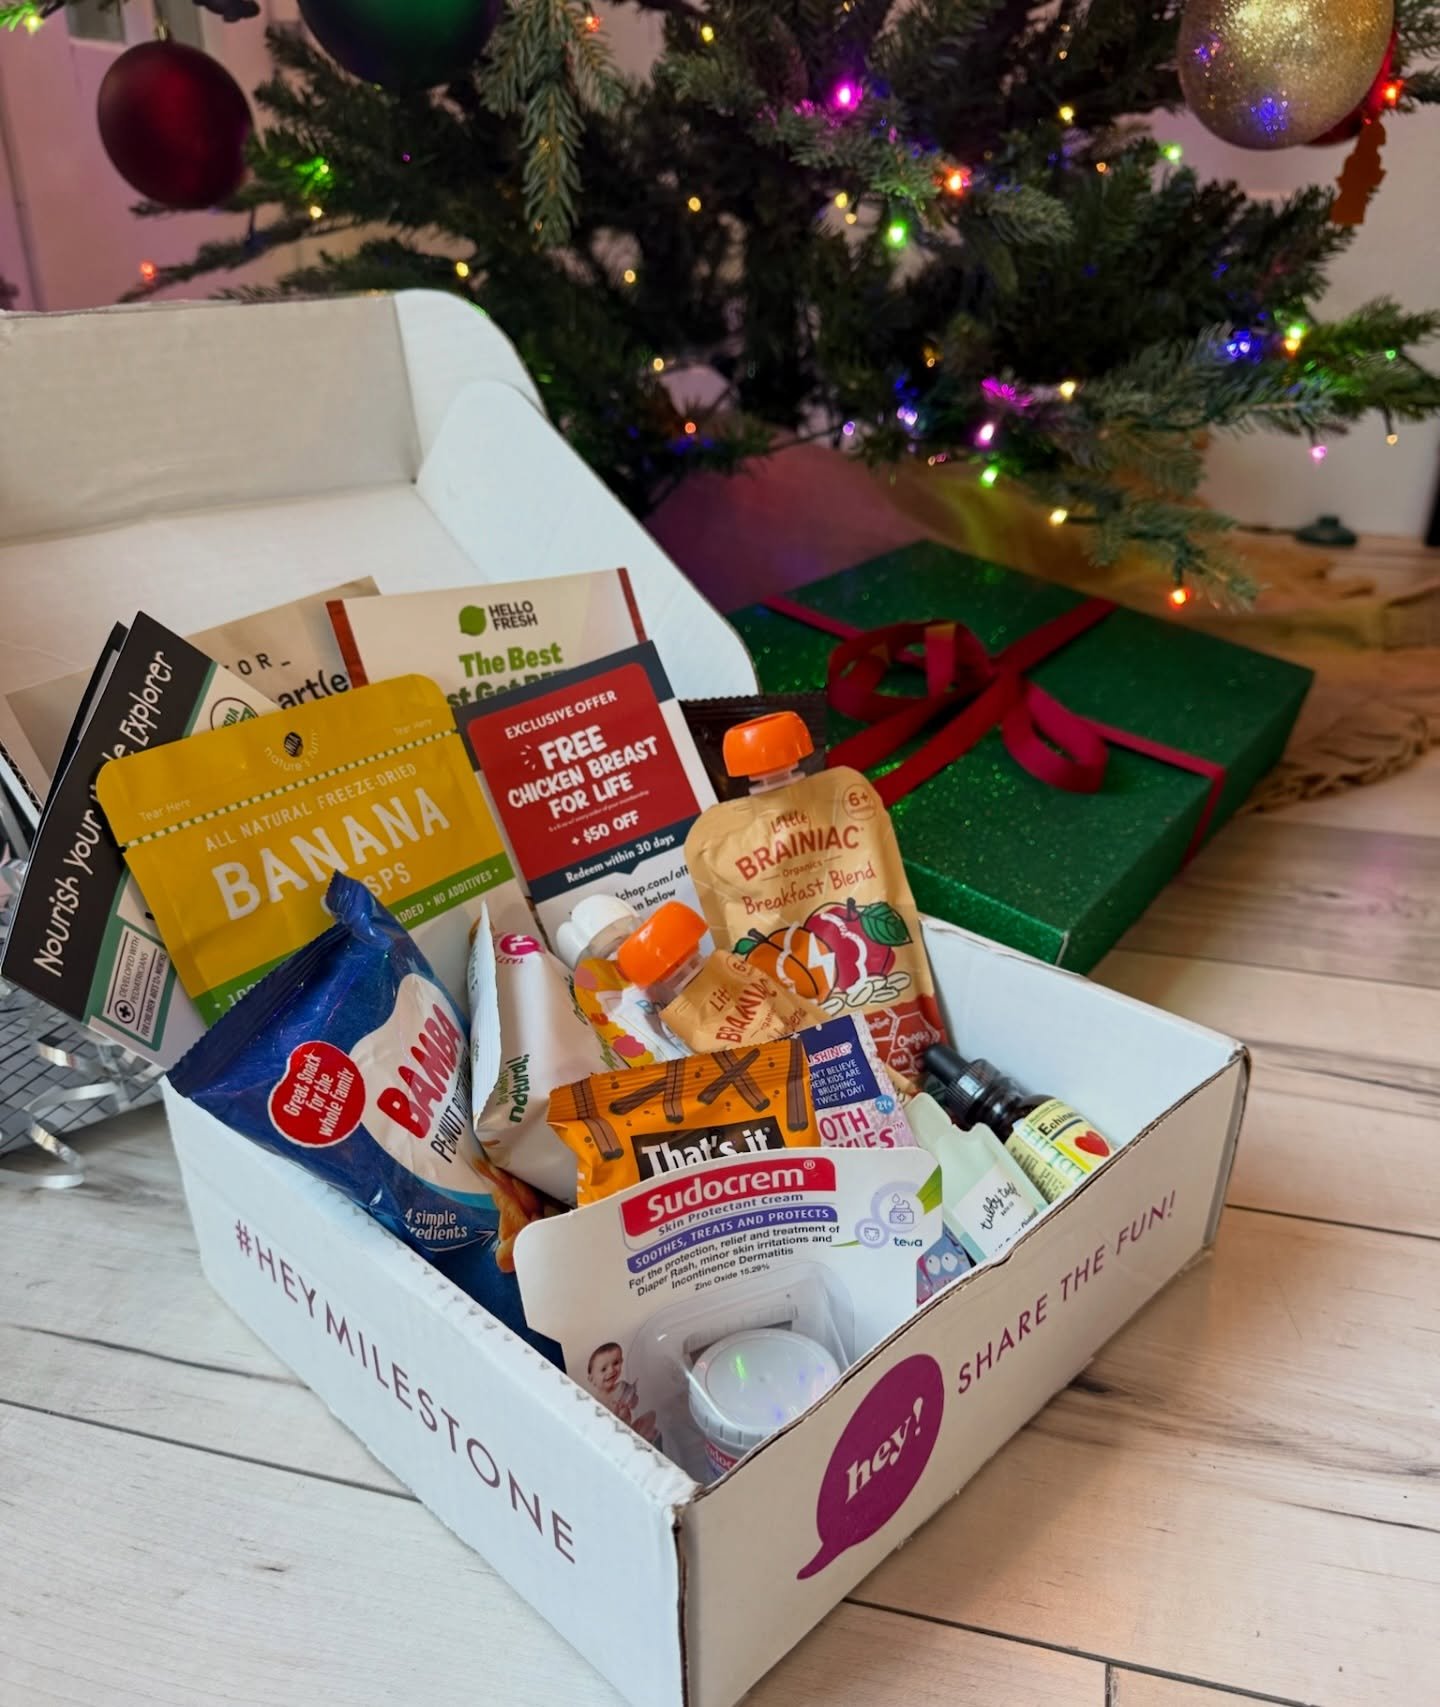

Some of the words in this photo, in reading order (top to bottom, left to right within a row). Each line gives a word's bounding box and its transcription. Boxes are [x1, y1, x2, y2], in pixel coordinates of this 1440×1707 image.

[488, 600, 533, 618] HELLO
[493, 613, 538, 631] FRESH
[458, 651, 505, 678] The
[507, 642, 563, 671] Best
[504, 705, 575, 740] EXCLUSIVE
[574, 690, 618, 714] OFFER
[538, 724, 608, 771] FREE
[507, 765, 585, 808] CHICKEN
[586, 736, 658, 779] BREAST
[33, 876, 80, 978] Nourish
[63, 808, 102, 876] your
[119, 650, 174, 748] Explorer
[204, 829, 238, 853] ALL
[239, 800, 313, 838] NATURAL
[316, 762, 418, 810] FREEZE-DRIED
[548, 789, 590, 819] FOR
[848, 792, 868, 807] 6+
[583, 823, 610, 844] $50
[613, 810, 639, 830] OFF
[211, 786, 450, 921] BANANA
[565, 863, 604, 884] Redeem
[605, 850, 636, 867] within
[636, 842, 651, 856] 30
[653, 834, 675, 850] days
[735, 825, 859, 881] BRAINIAC
[782, 860, 823, 877] Organics
[433, 894, 447, 907] NO
[447, 872, 493, 901] ADDITIVES
[645, 888, 676, 906] below
[742, 878, 824, 915] Breakfast
[828, 860, 877, 890] Blend
[296, 1050, 322, 1085] Snack
[376, 1003, 462, 1139] BAMBA
[807, 1042, 853, 1065] USHING?
[810, 1067, 826, 1081] ON'T
[827, 1059, 858, 1075] BELIEVE
[313, 1073, 334, 1095] the
[329, 1067, 355, 1103] family
[810, 1078, 828, 1090] HEIR
[828, 1073, 845, 1085] KIDS
[845, 1067, 861, 1078] ARE
[816, 1092, 840, 1106] TWICE
[847, 1085, 866, 1097] DAY!
[818, 1079, 857, 1096] BRUSHING
[283, 1083, 310, 1117] Great
[305, 1092, 326, 1112] for
[319, 1101, 343, 1137] whole
[430, 1104, 466, 1164] PEANUT
[820, 1107, 870, 1141] OTH
[647, 1168, 805, 1223] Sudocrem
[405, 1208, 412, 1223] 4
[415, 1210, 457, 1226] simple
[658, 1219, 685, 1237] Skin
[687, 1199, 757, 1224] Protectant
[761, 1194, 804, 1206] Cream
[635, 1237, 688, 1269] SOOTHES,
[691, 1221, 734, 1241] TREATS
[737, 1214, 764, 1228] AND
[768, 1208, 830, 1223] PROTECTS
[893, 1236, 923, 1247] teva
[629, 1277, 646, 1290] For
[648, 1267, 663, 1281] the
[665, 1243, 719, 1272] protection,
[720, 1234, 748, 1249] relief
[749, 1227, 771, 1241] and
[772, 1224, 827, 1237] treatment
[828, 1224, 840, 1234] of
[637, 1275, 669, 1298] Diaper
[670, 1261, 698, 1279] Rash,
[699, 1250, 730, 1265] minor
[732, 1243, 755, 1256] skin
[757, 1236, 810, 1250] irritations
[811, 1234, 833, 1244] and
[671, 1260, 736, 1290] Incontinence
[738, 1247, 794, 1265] Dermatitis
[694, 1279, 713, 1292] Zinc
[713, 1270, 738, 1285] Oxide
[957, 1293, 1048, 1395] SHARE
[1059, 1244, 1105, 1302] THE
[1115, 1190, 1177, 1257] FUN!
[845, 1396, 924, 1504] hey!
